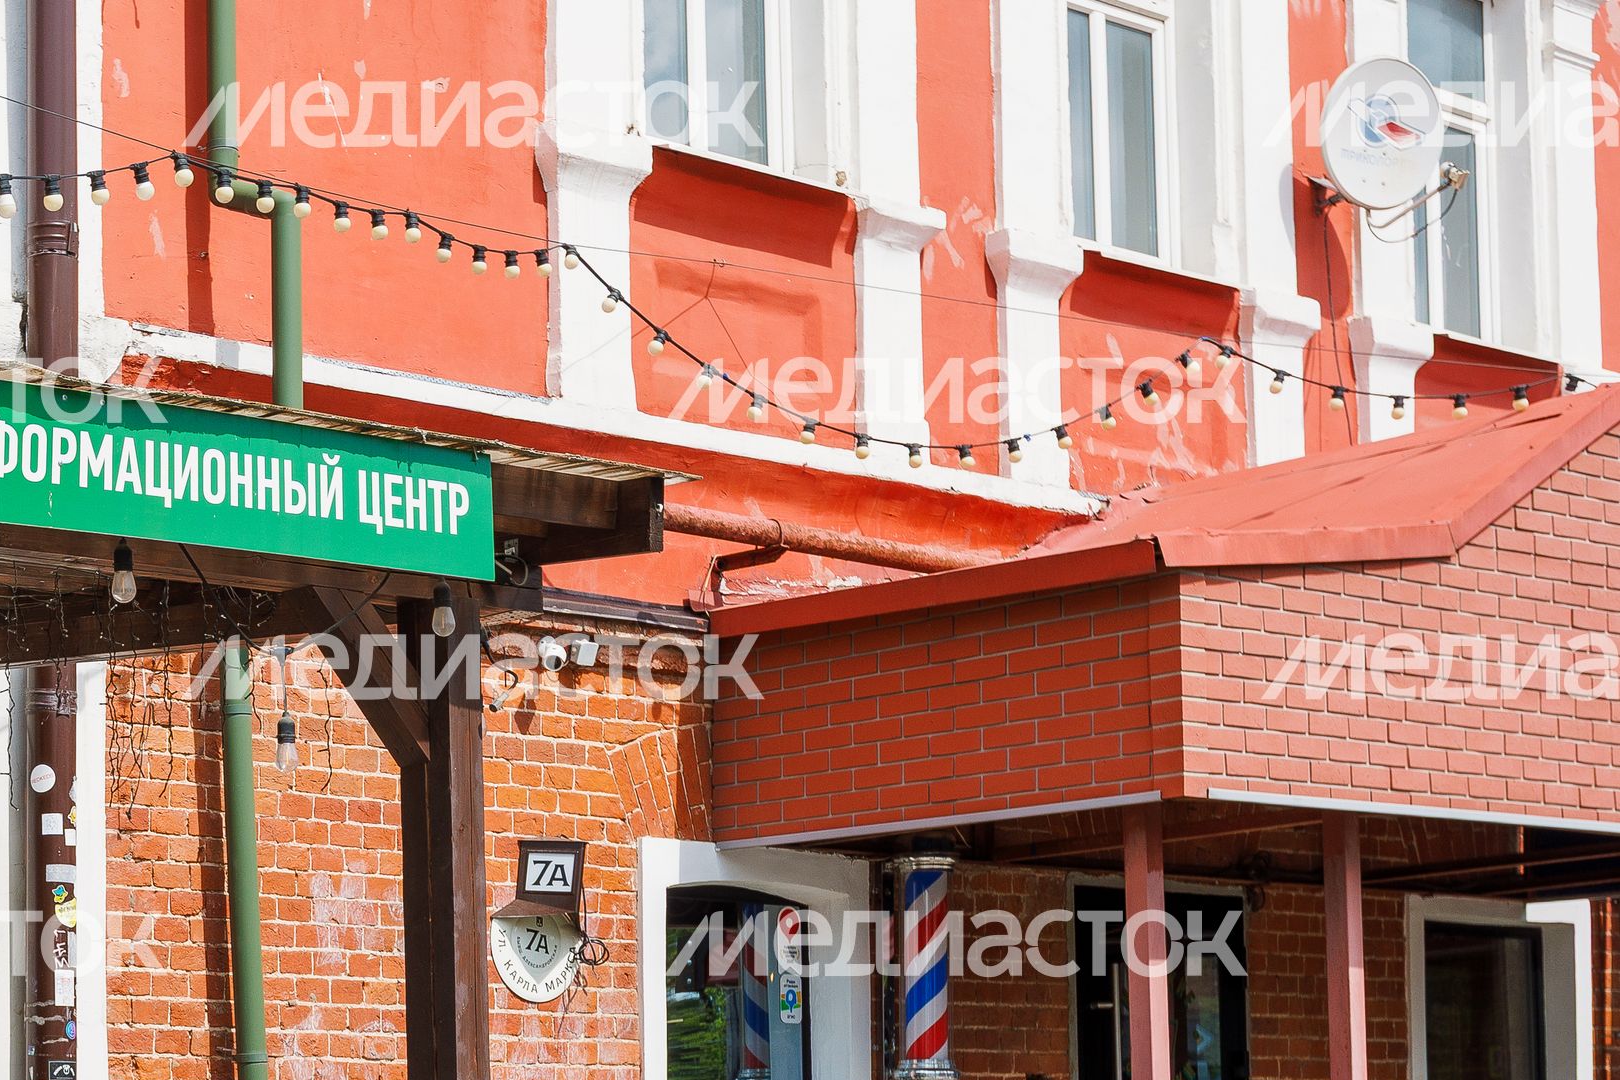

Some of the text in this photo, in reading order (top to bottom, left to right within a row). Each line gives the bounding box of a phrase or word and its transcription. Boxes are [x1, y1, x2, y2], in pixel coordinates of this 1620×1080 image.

[358, 470, 470, 536] ЦЕНТР
[503, 959, 539, 994] КАРЛА
[545, 946, 578, 993] МАРКСА
